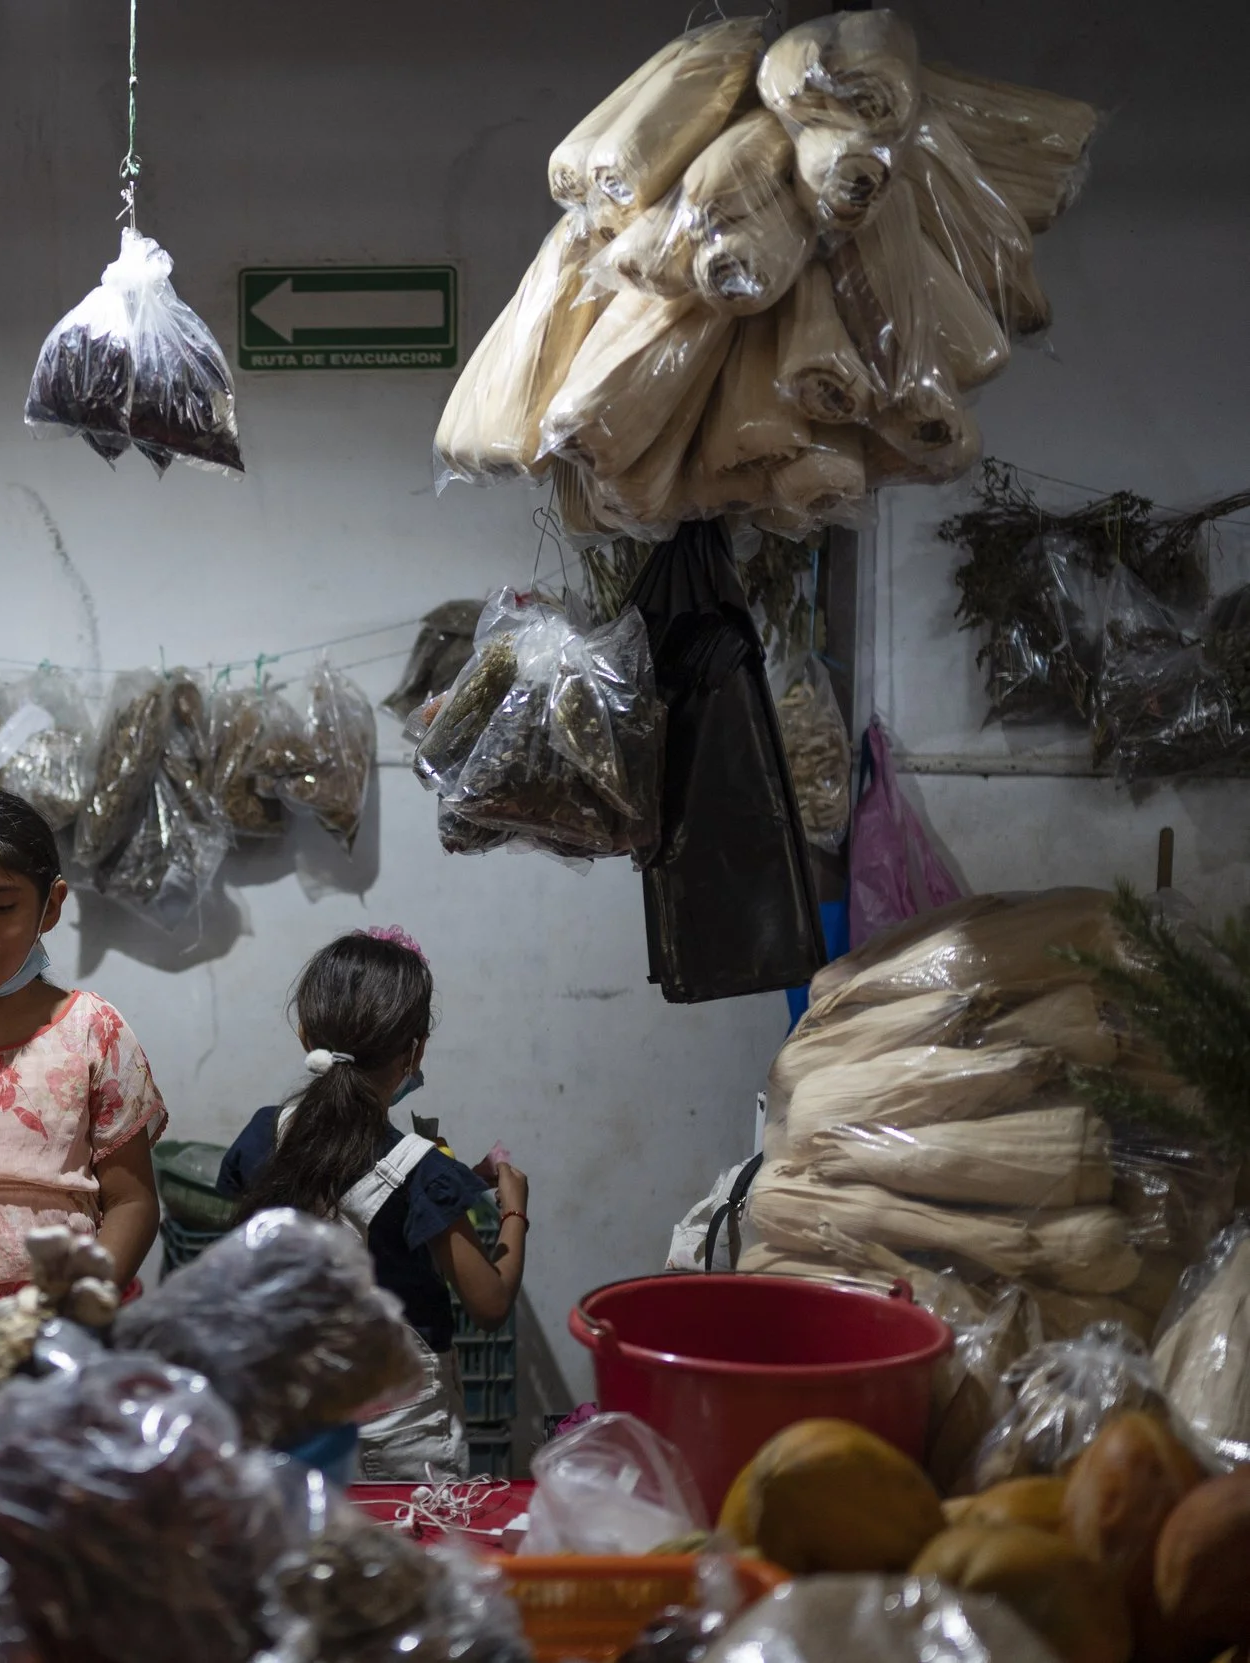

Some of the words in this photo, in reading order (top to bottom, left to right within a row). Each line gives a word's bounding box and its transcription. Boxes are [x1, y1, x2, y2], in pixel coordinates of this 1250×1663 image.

[251, 354, 299, 366] RUTA
[302, 354, 326, 365] DE
[330, 352, 442, 365] EVACUACION
